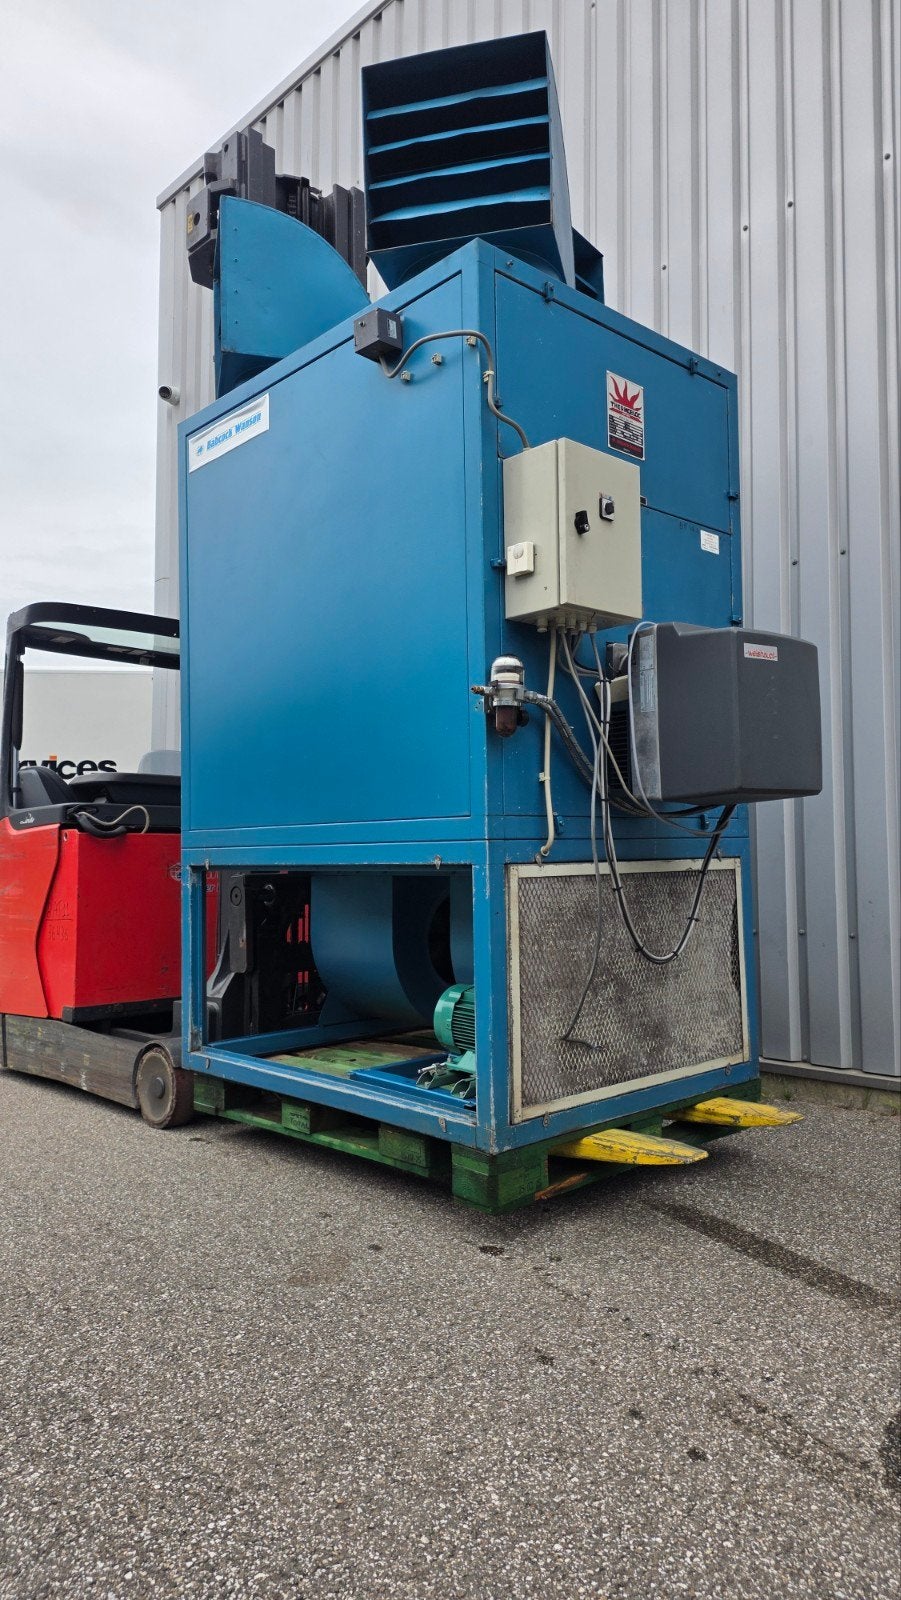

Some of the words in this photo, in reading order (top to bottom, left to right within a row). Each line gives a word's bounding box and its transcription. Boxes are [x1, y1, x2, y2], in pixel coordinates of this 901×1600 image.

[206, 428, 233, 450] Babcock
[234, 412, 262, 434] Wanson
[18, 755, 117, 779] ices
